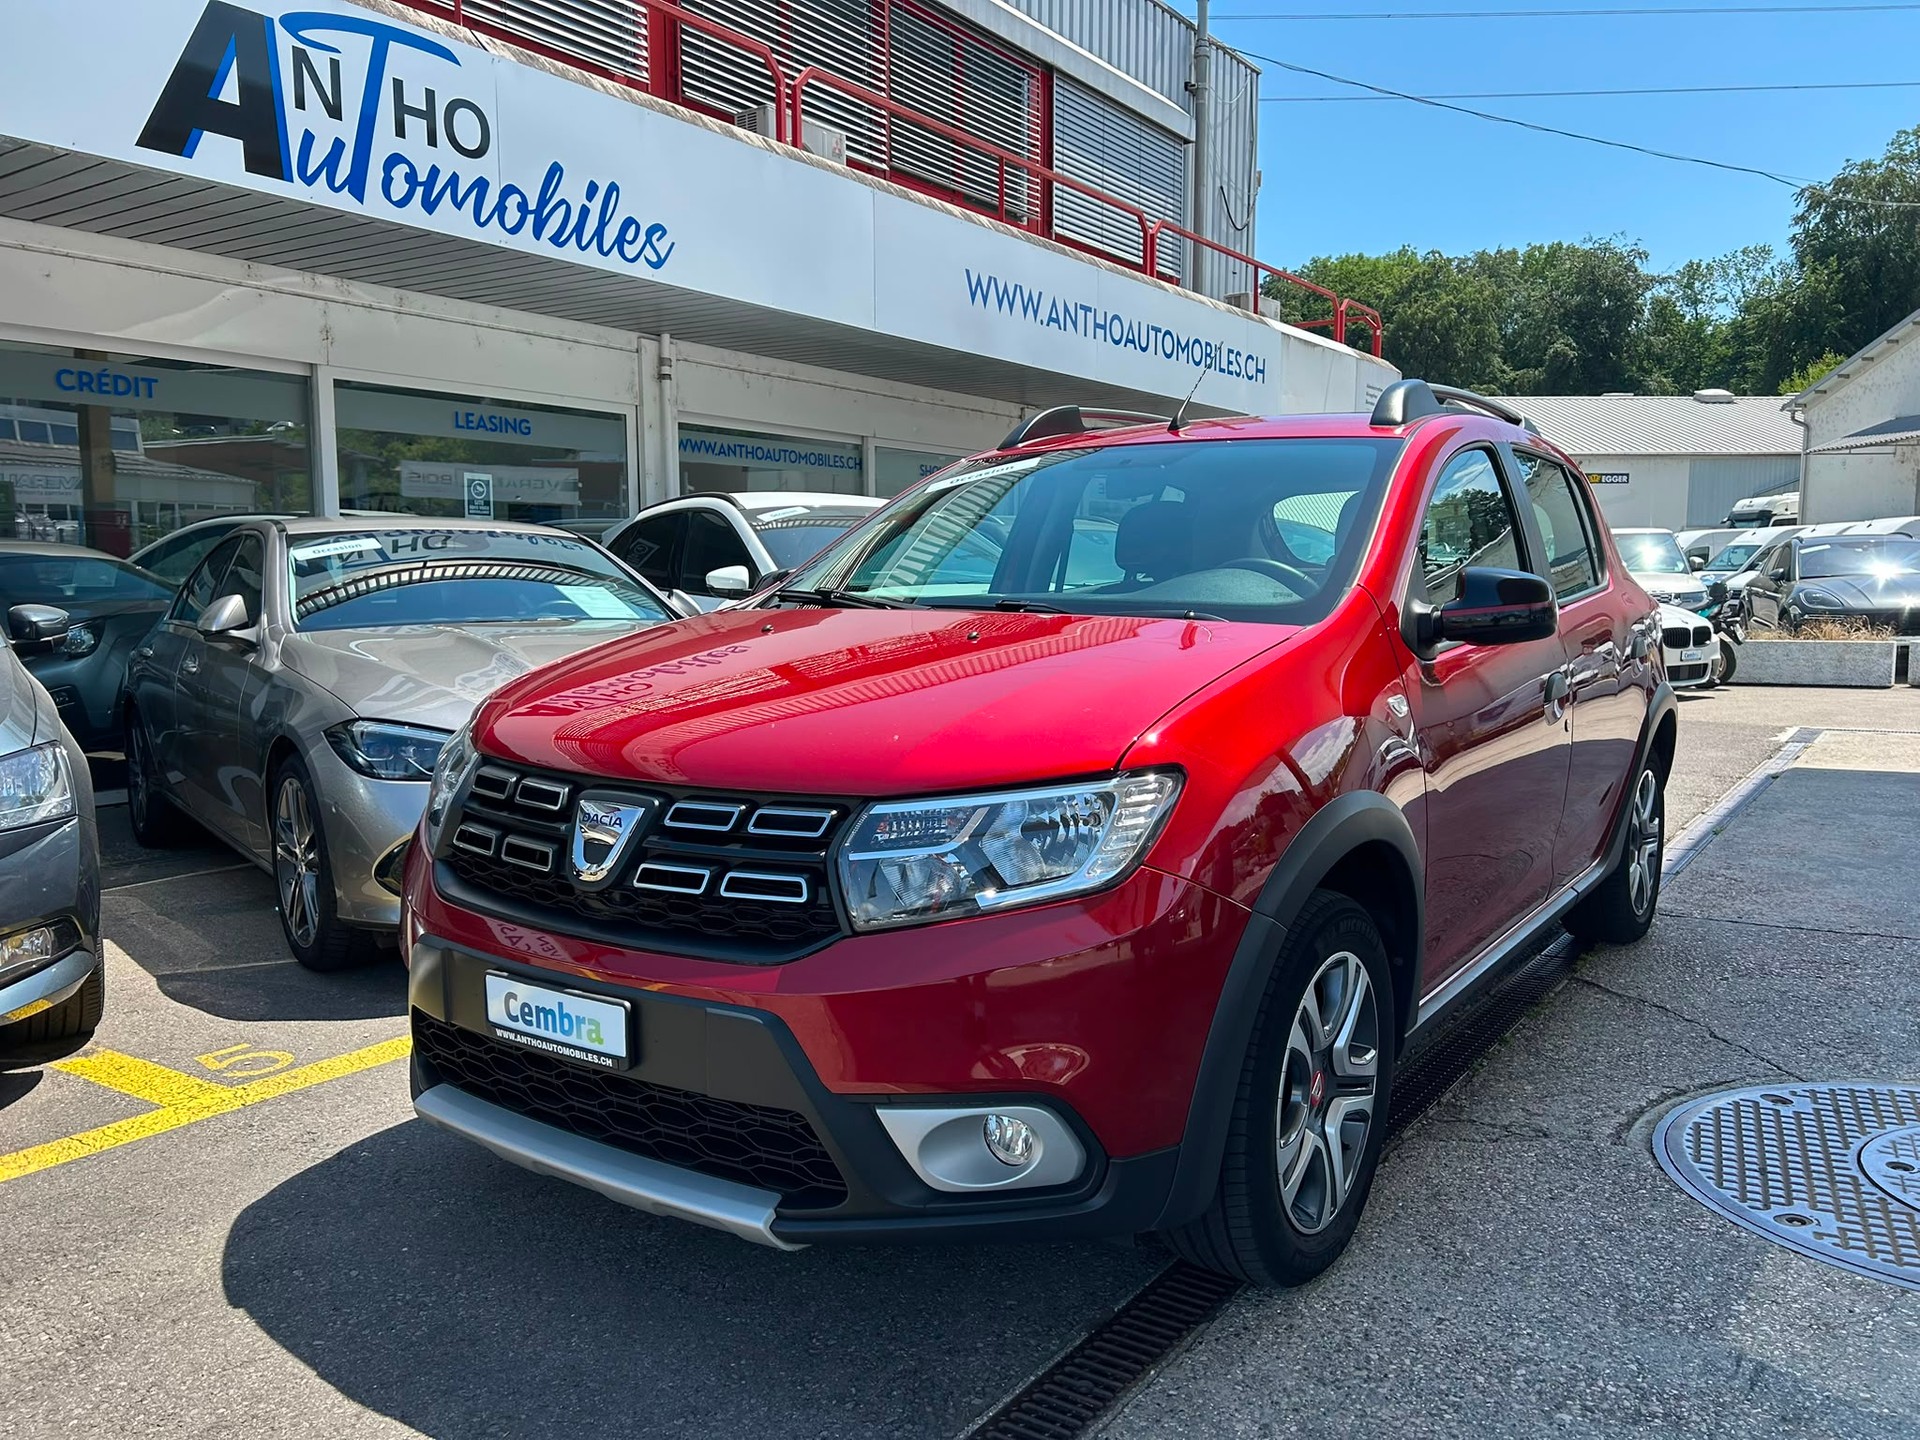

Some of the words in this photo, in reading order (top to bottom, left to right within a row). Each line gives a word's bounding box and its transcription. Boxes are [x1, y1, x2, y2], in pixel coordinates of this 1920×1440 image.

[135, 0, 491, 205] ANTHO
[964, 267, 1266, 384] WWW.ANTHOAUTOMOBILES.CH
[55, 368, 159, 399] CRÉDIT
[454, 411, 532, 436] LEASING
[1601, 475, 1628, 483] EGGER
[312, 542, 363, 555] Occasion
[582, 812, 623, 828] DACIA
[503, 991, 604, 1045] Cembra
[193, 1042, 295, 1078] 5
[495, 1028, 613, 1067] WWW.ANTHOAUTOMOBILES.CH
